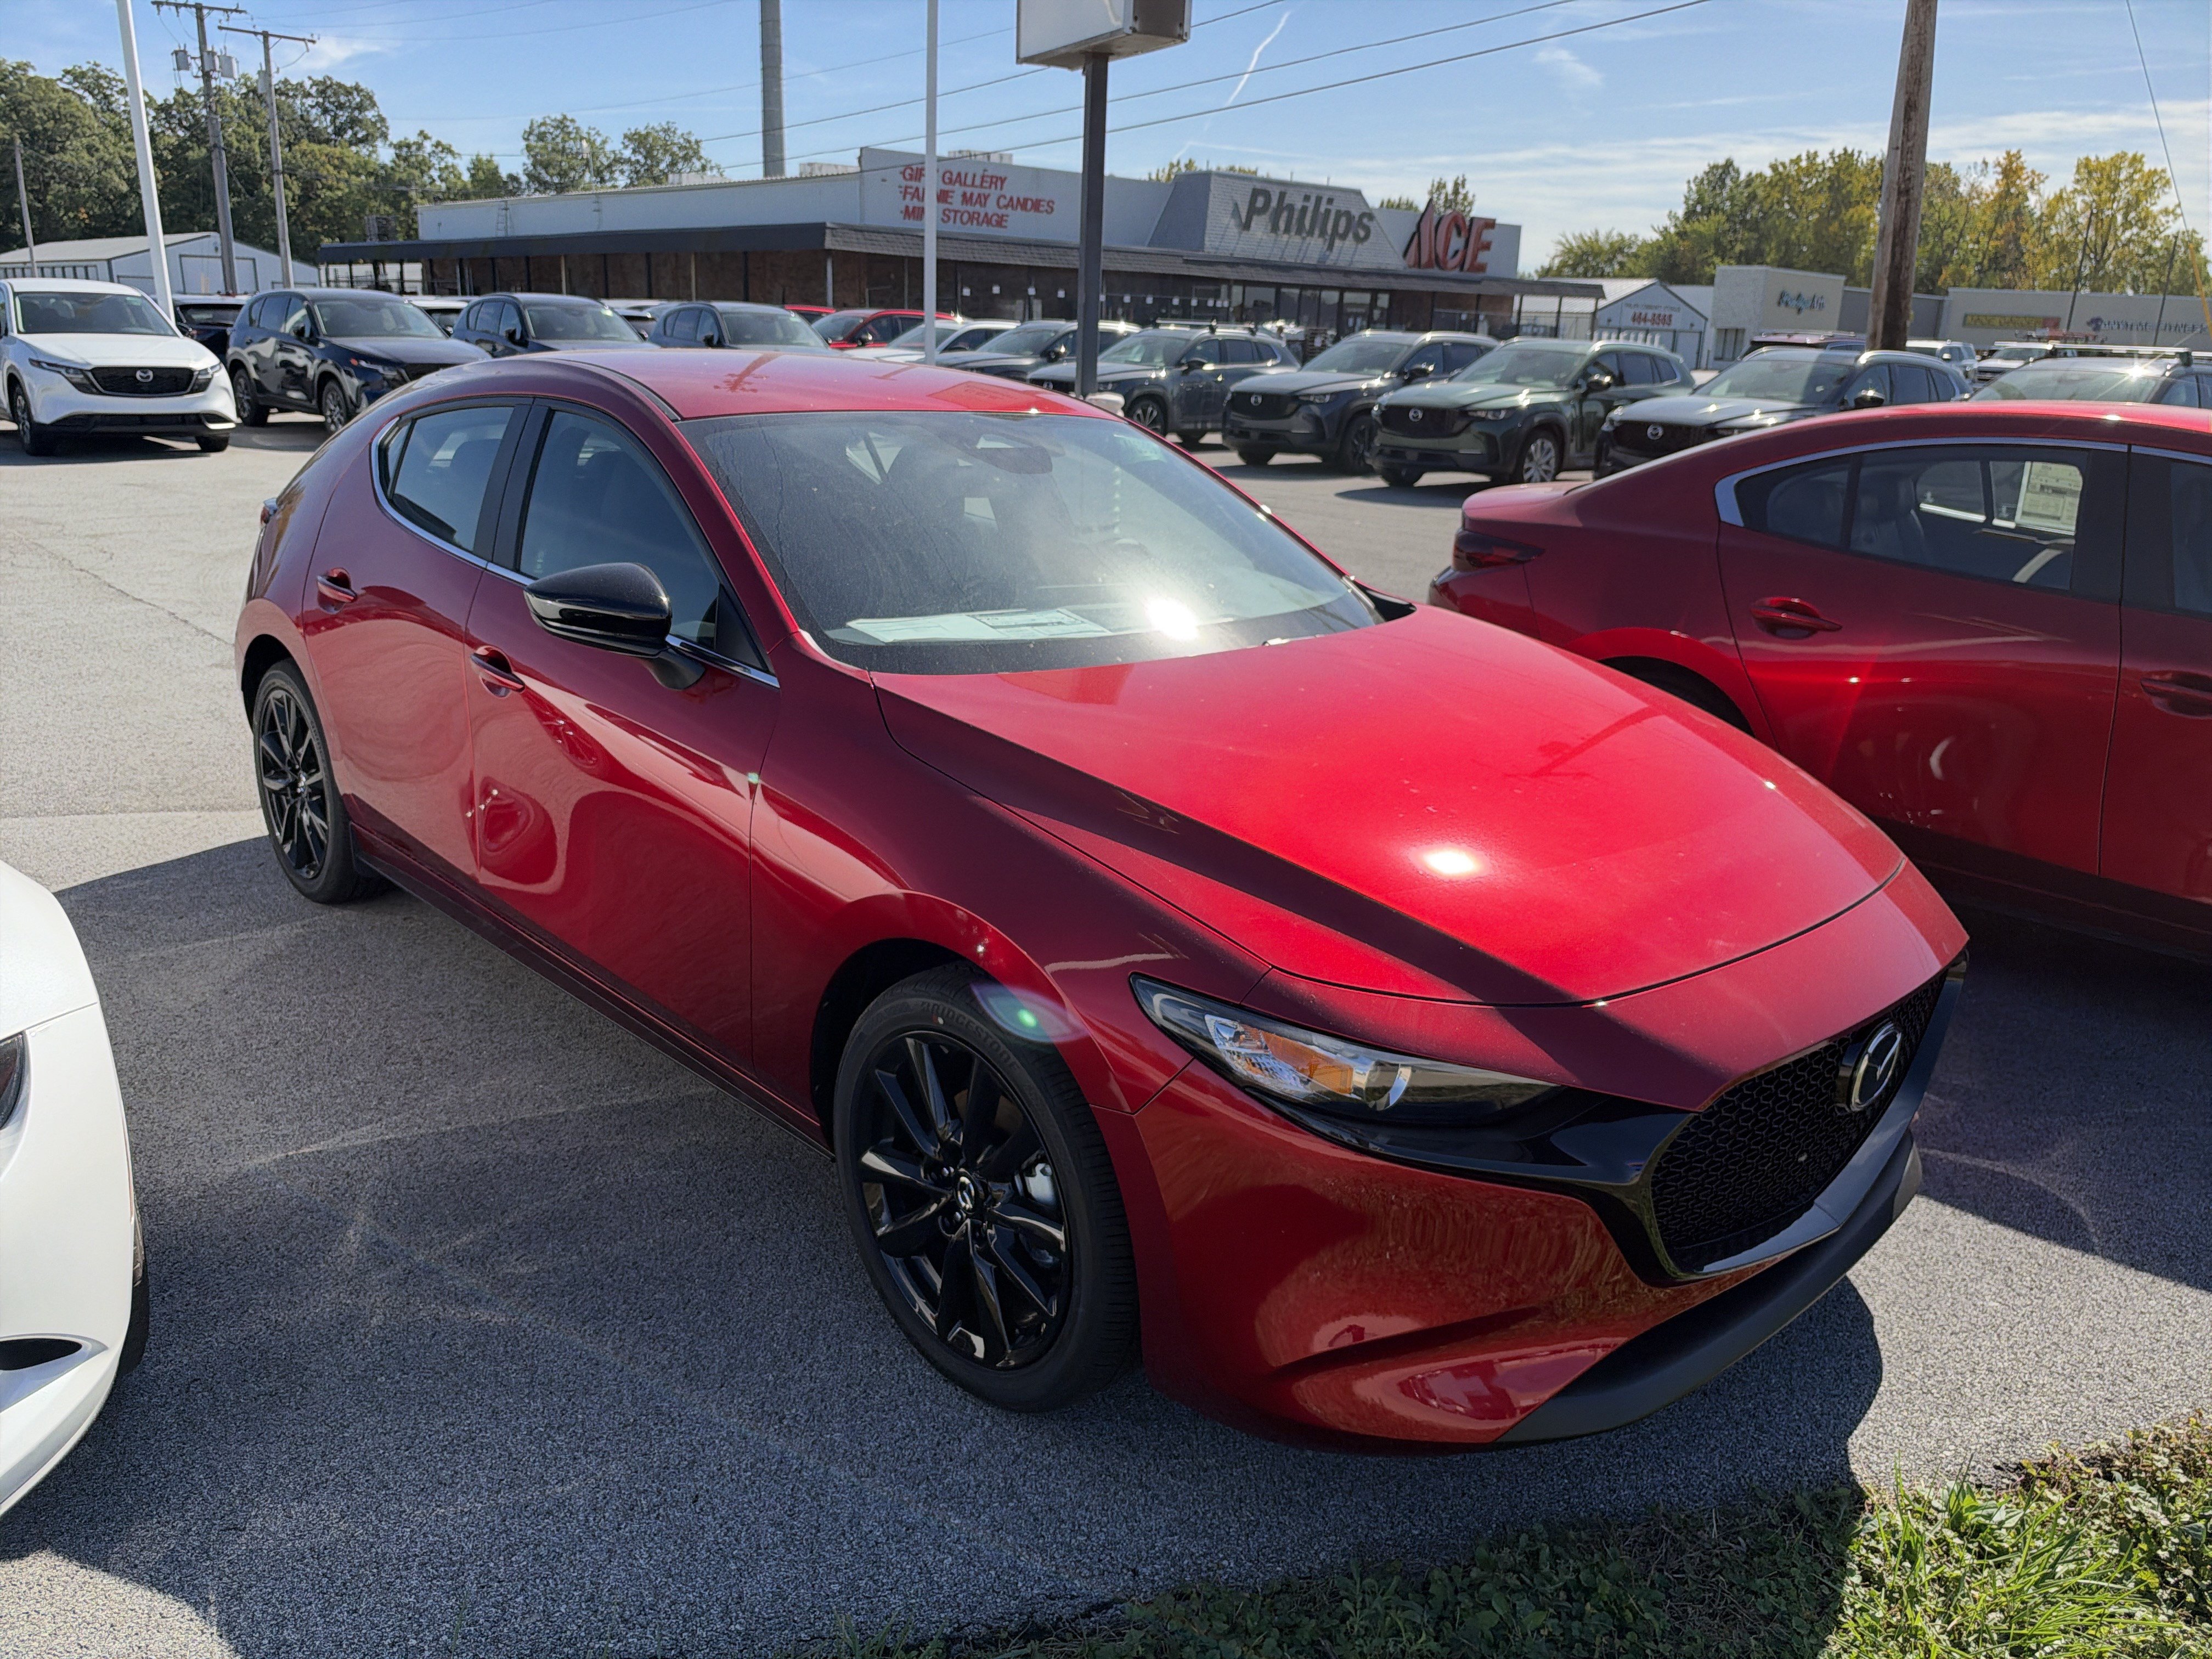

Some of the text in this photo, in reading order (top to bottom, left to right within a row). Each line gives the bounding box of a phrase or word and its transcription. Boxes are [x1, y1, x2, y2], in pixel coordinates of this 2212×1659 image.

[903, 167, 1007, 190] GIF GALLERY
[961, 191, 991, 207] MAY
[997, 195, 1055, 215] CANDIES
[941, 208, 1009, 228] STORAGE
[1242, 187, 1375, 252] Philips
[1403, 198, 1497, 272] ACE
